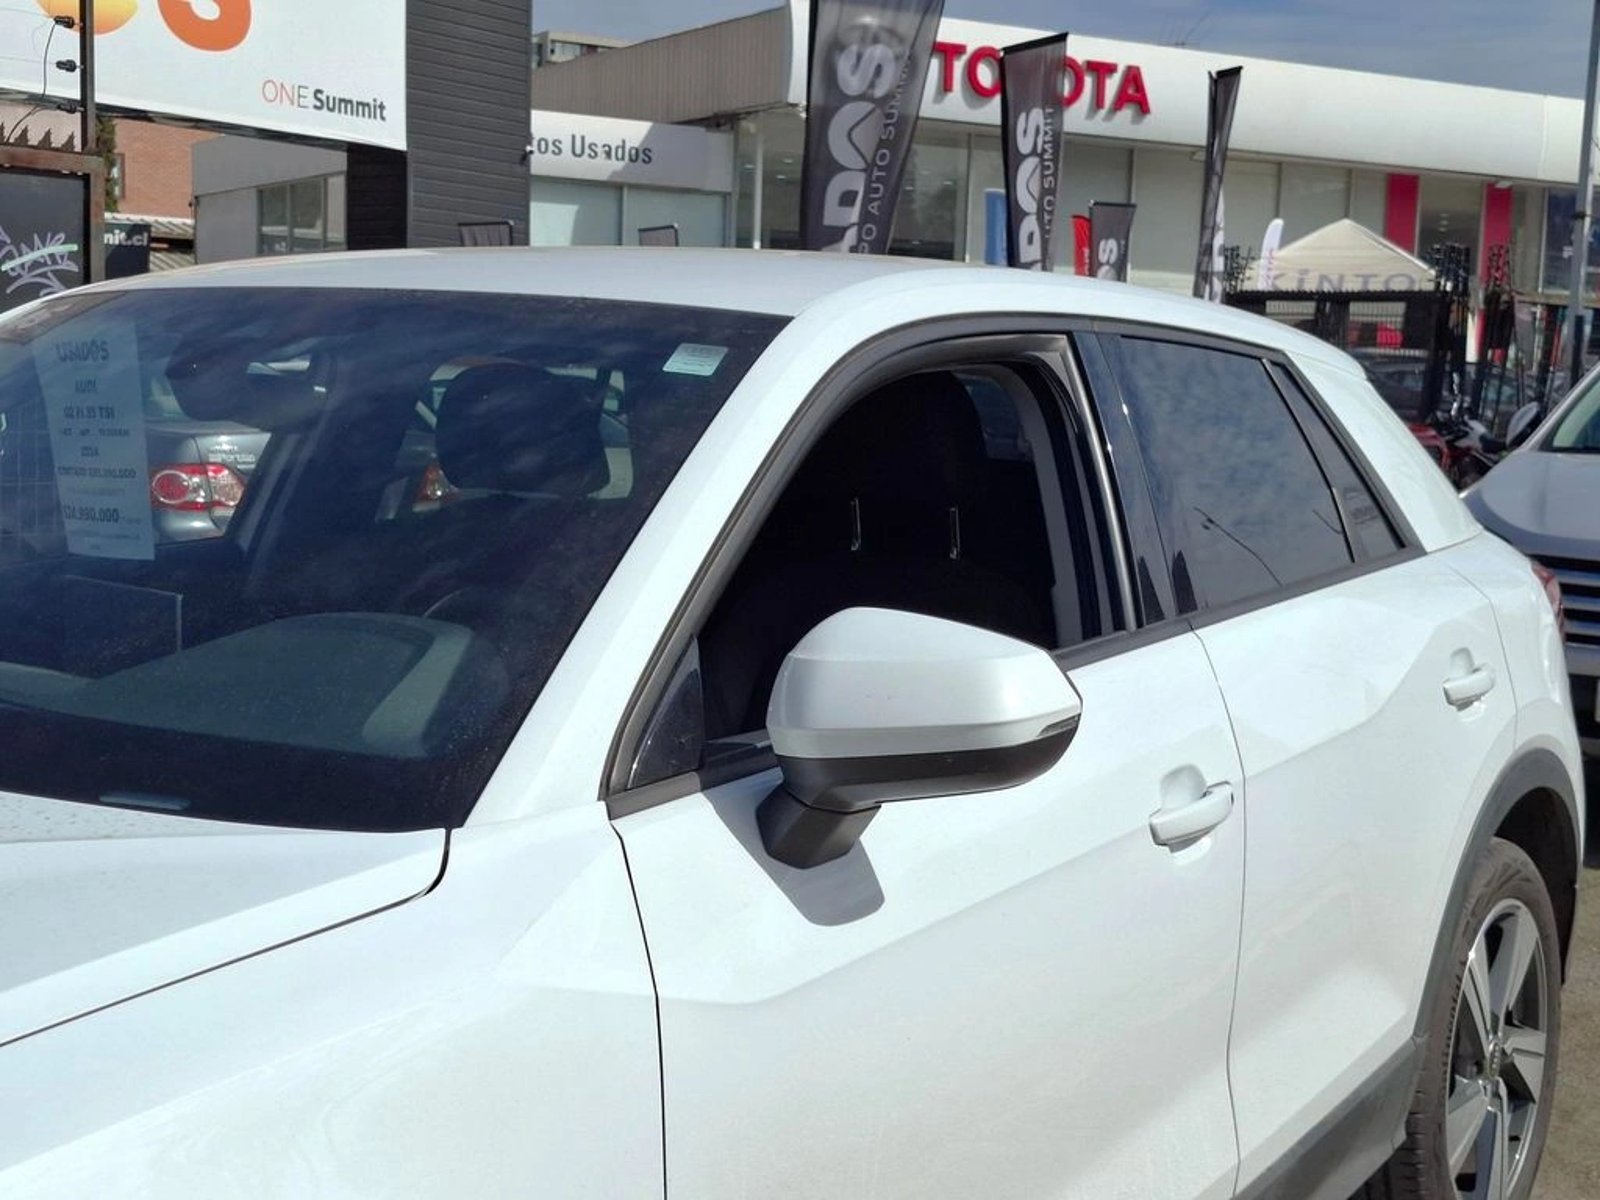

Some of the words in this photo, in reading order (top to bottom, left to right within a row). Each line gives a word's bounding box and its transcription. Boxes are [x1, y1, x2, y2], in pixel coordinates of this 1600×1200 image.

[262, 79, 309, 109] ONE
[313, 88, 386, 122] Summit
[933, 42, 1150, 114] TOOTA
[531, 136, 563, 156] os
[571, 134, 652, 164] Usados
[867, 149, 890, 215] AUTO
[1042, 108, 1056, 190] SUMMIT
